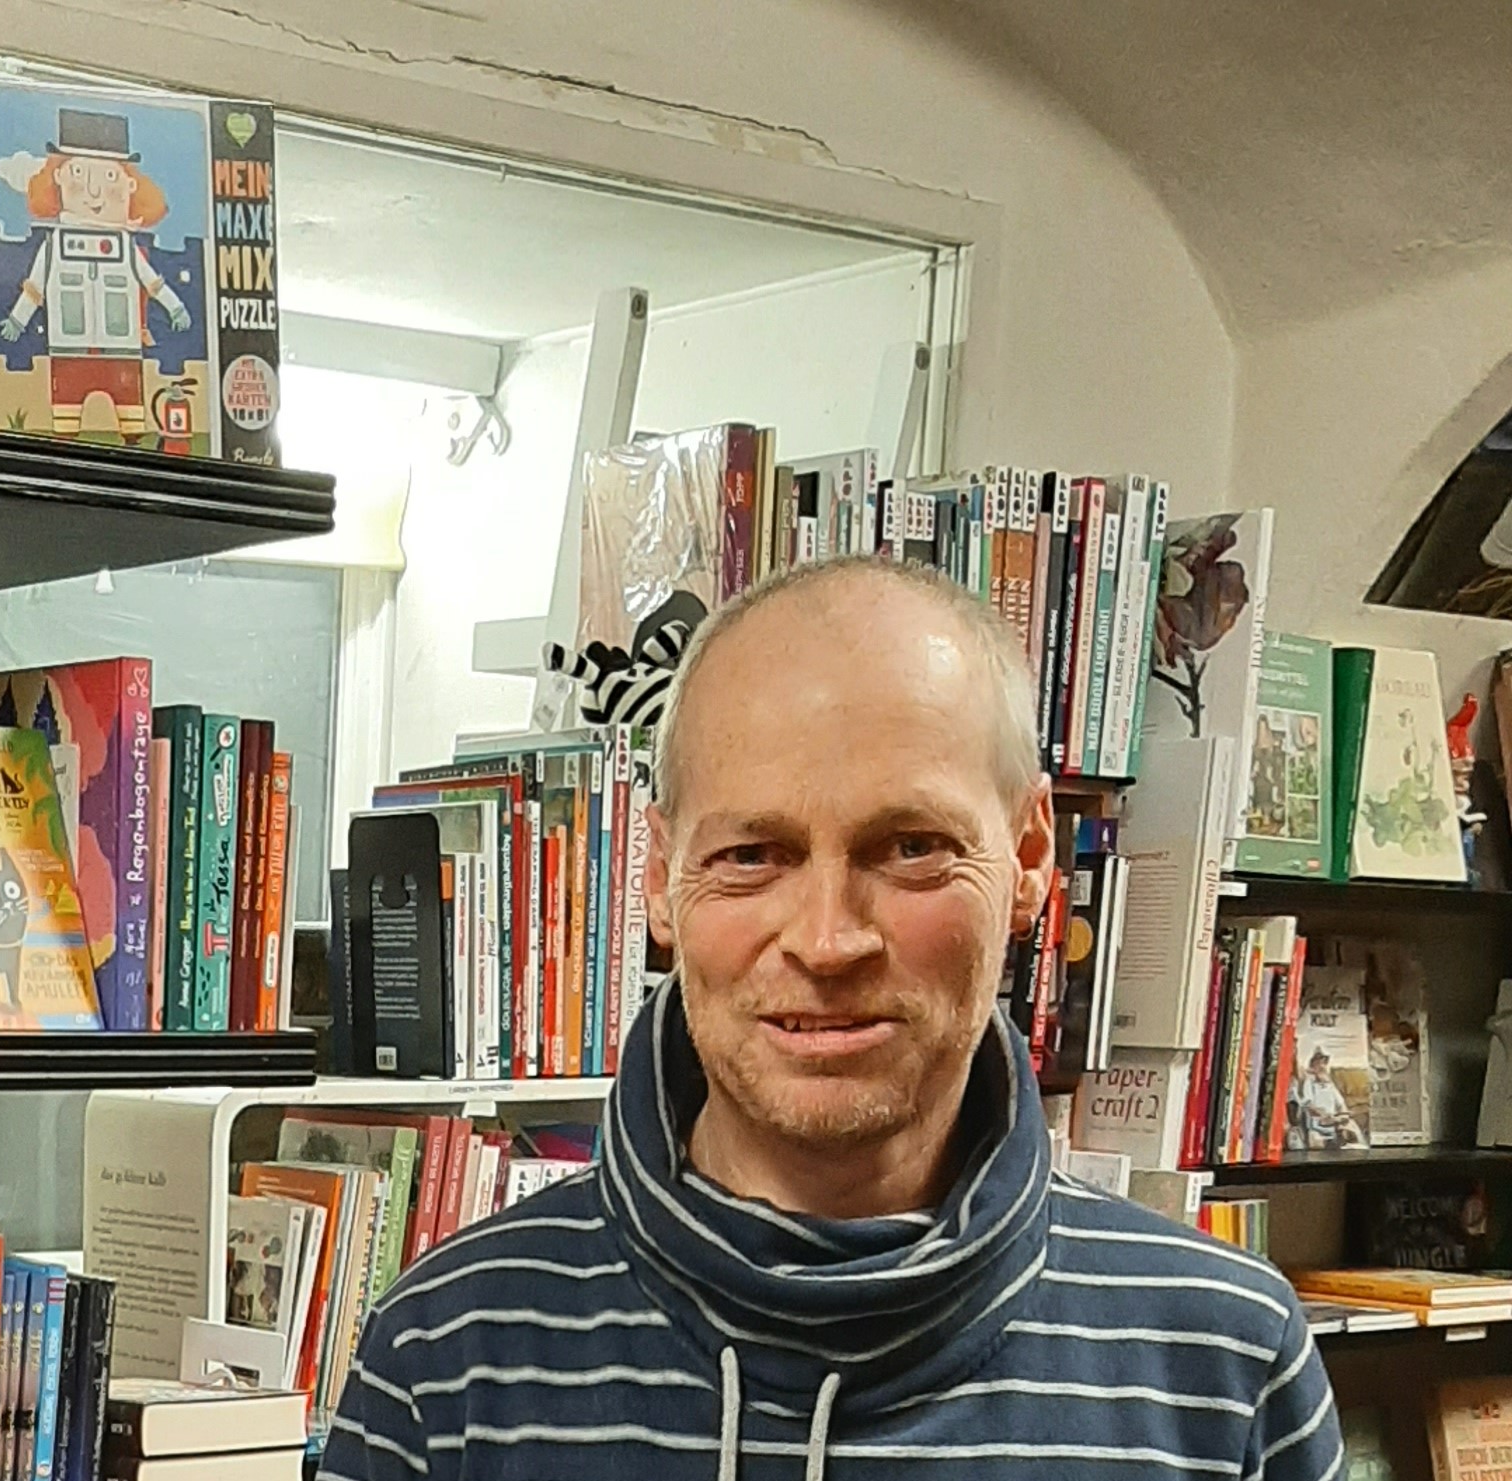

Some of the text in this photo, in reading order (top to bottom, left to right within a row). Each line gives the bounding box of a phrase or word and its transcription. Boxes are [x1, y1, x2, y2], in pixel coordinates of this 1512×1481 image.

[215, 159, 272, 198] MEIN
[218, 246, 274, 291] MIX
[220, 297, 276, 330] PUZZLE
[996, 470, 1006, 523] TOPP
[1012, 472, 1022, 524] TOPP
[1025, 475, 1036, 527] TOPP
[1057, 479, 1067, 528] TOPP
[1155, 487, 1166, 535] TOPP
[805, 523, 813, 558] OPP
[1105, 519, 1116, 566] TOPP
[618, 729, 628, 776] TOPP
[126, 711, 150, 883] Regenbogentage
